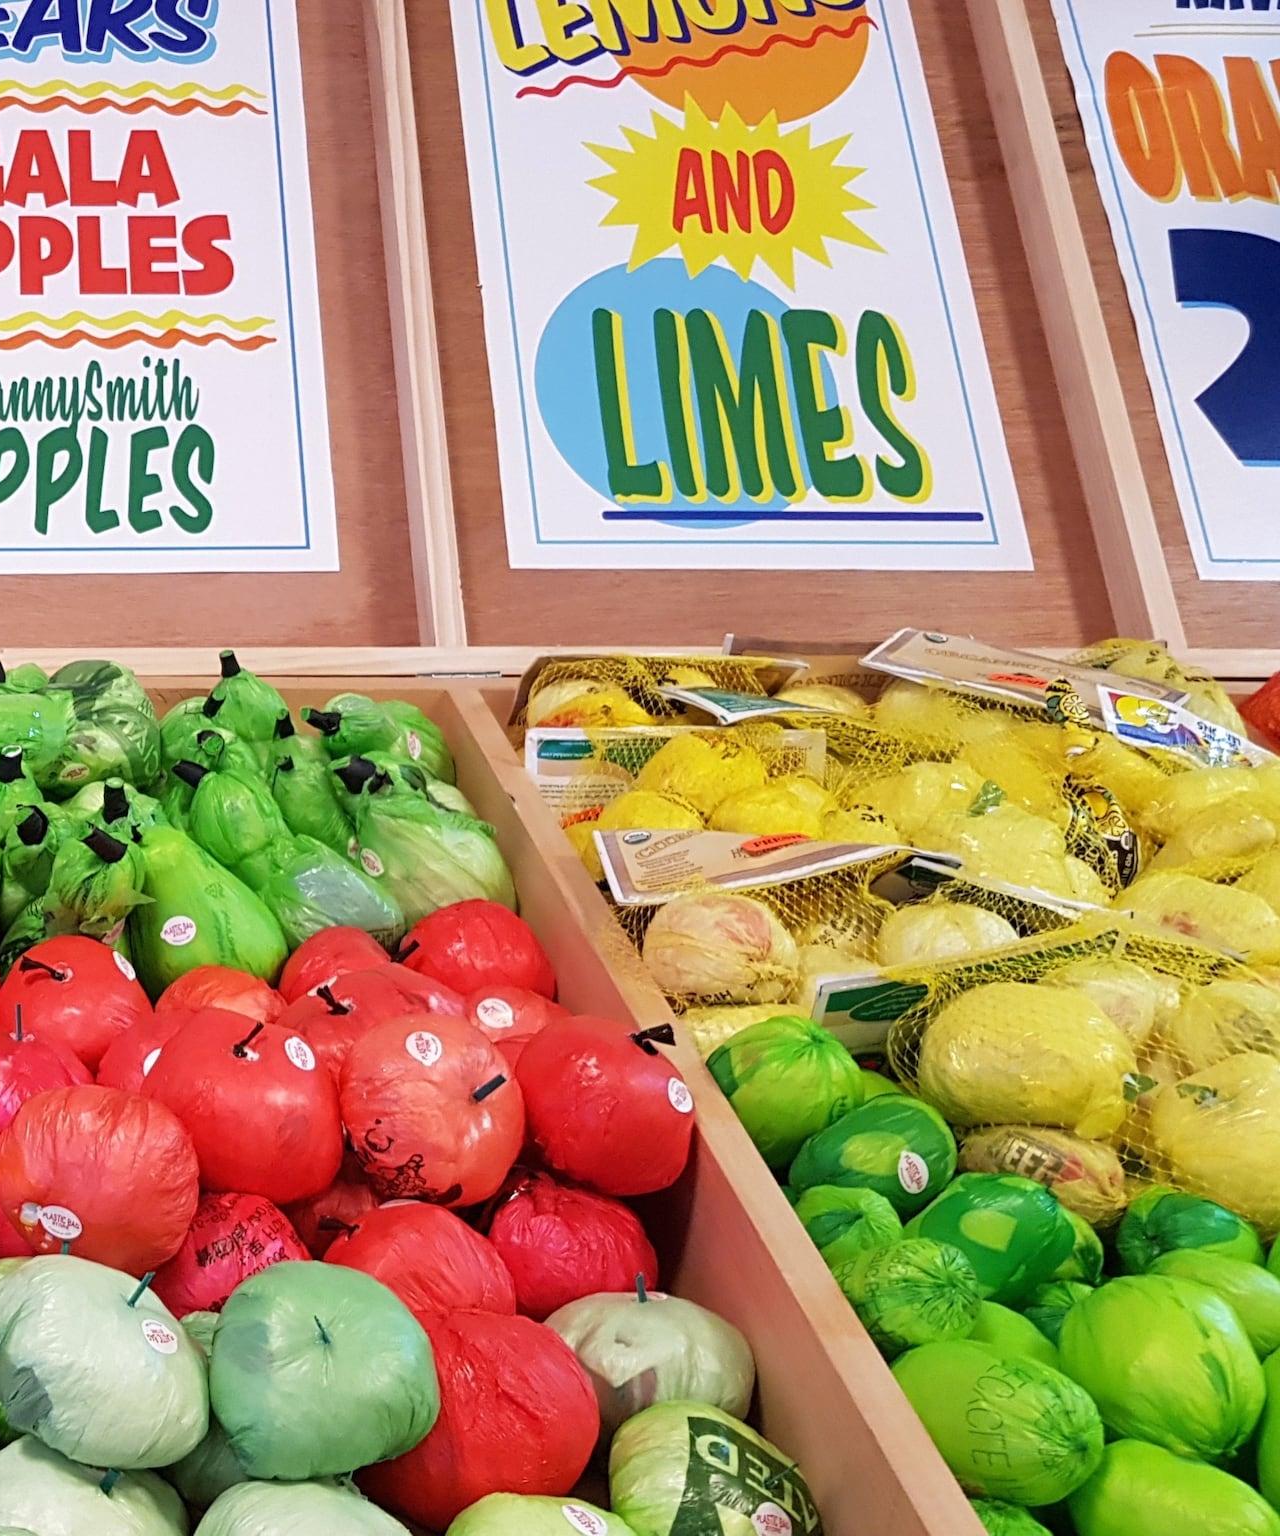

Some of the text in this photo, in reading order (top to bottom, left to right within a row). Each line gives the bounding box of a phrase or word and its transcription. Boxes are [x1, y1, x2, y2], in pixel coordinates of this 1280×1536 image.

[1104, 51, 1280, 203] ORA
[672, 148, 795, 235] AND
[592, 307, 933, 504] LIMES
[43, 1211, 81, 1231] PLASTIC BAG
